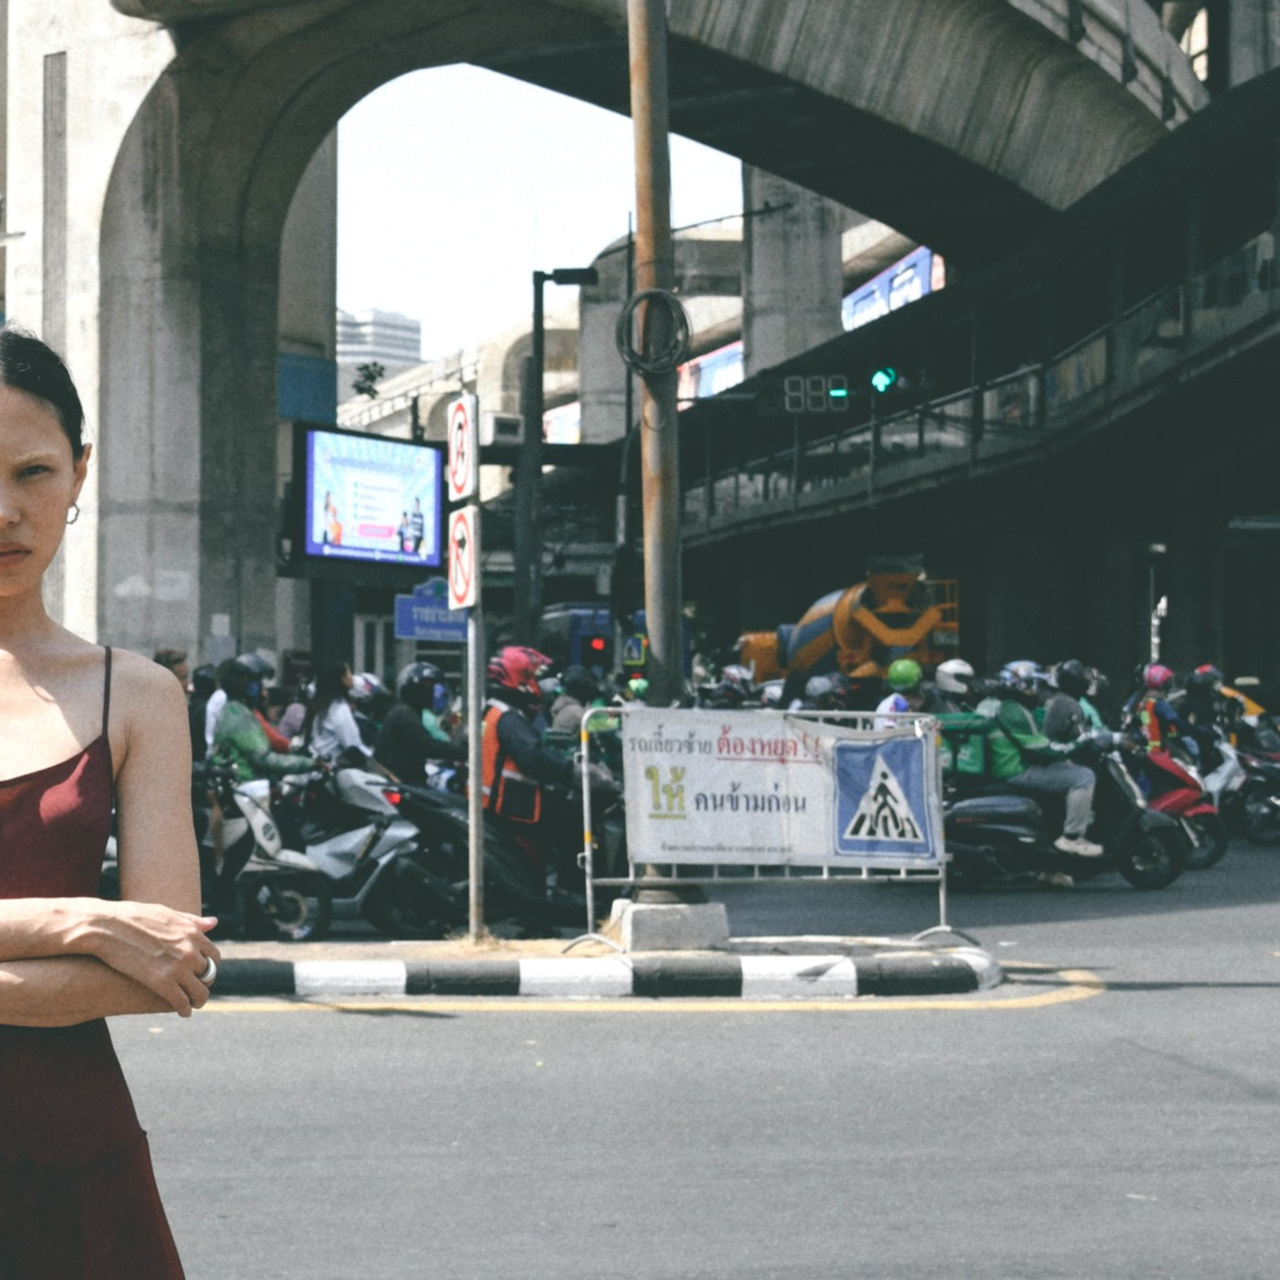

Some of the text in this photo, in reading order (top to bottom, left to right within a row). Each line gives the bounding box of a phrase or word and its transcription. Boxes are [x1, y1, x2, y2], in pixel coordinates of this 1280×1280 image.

[628, 724, 713, 755] รถเลี้ยวซ้าย
[644, 765, 807, 814] ให้ คนข้ามก่อน
